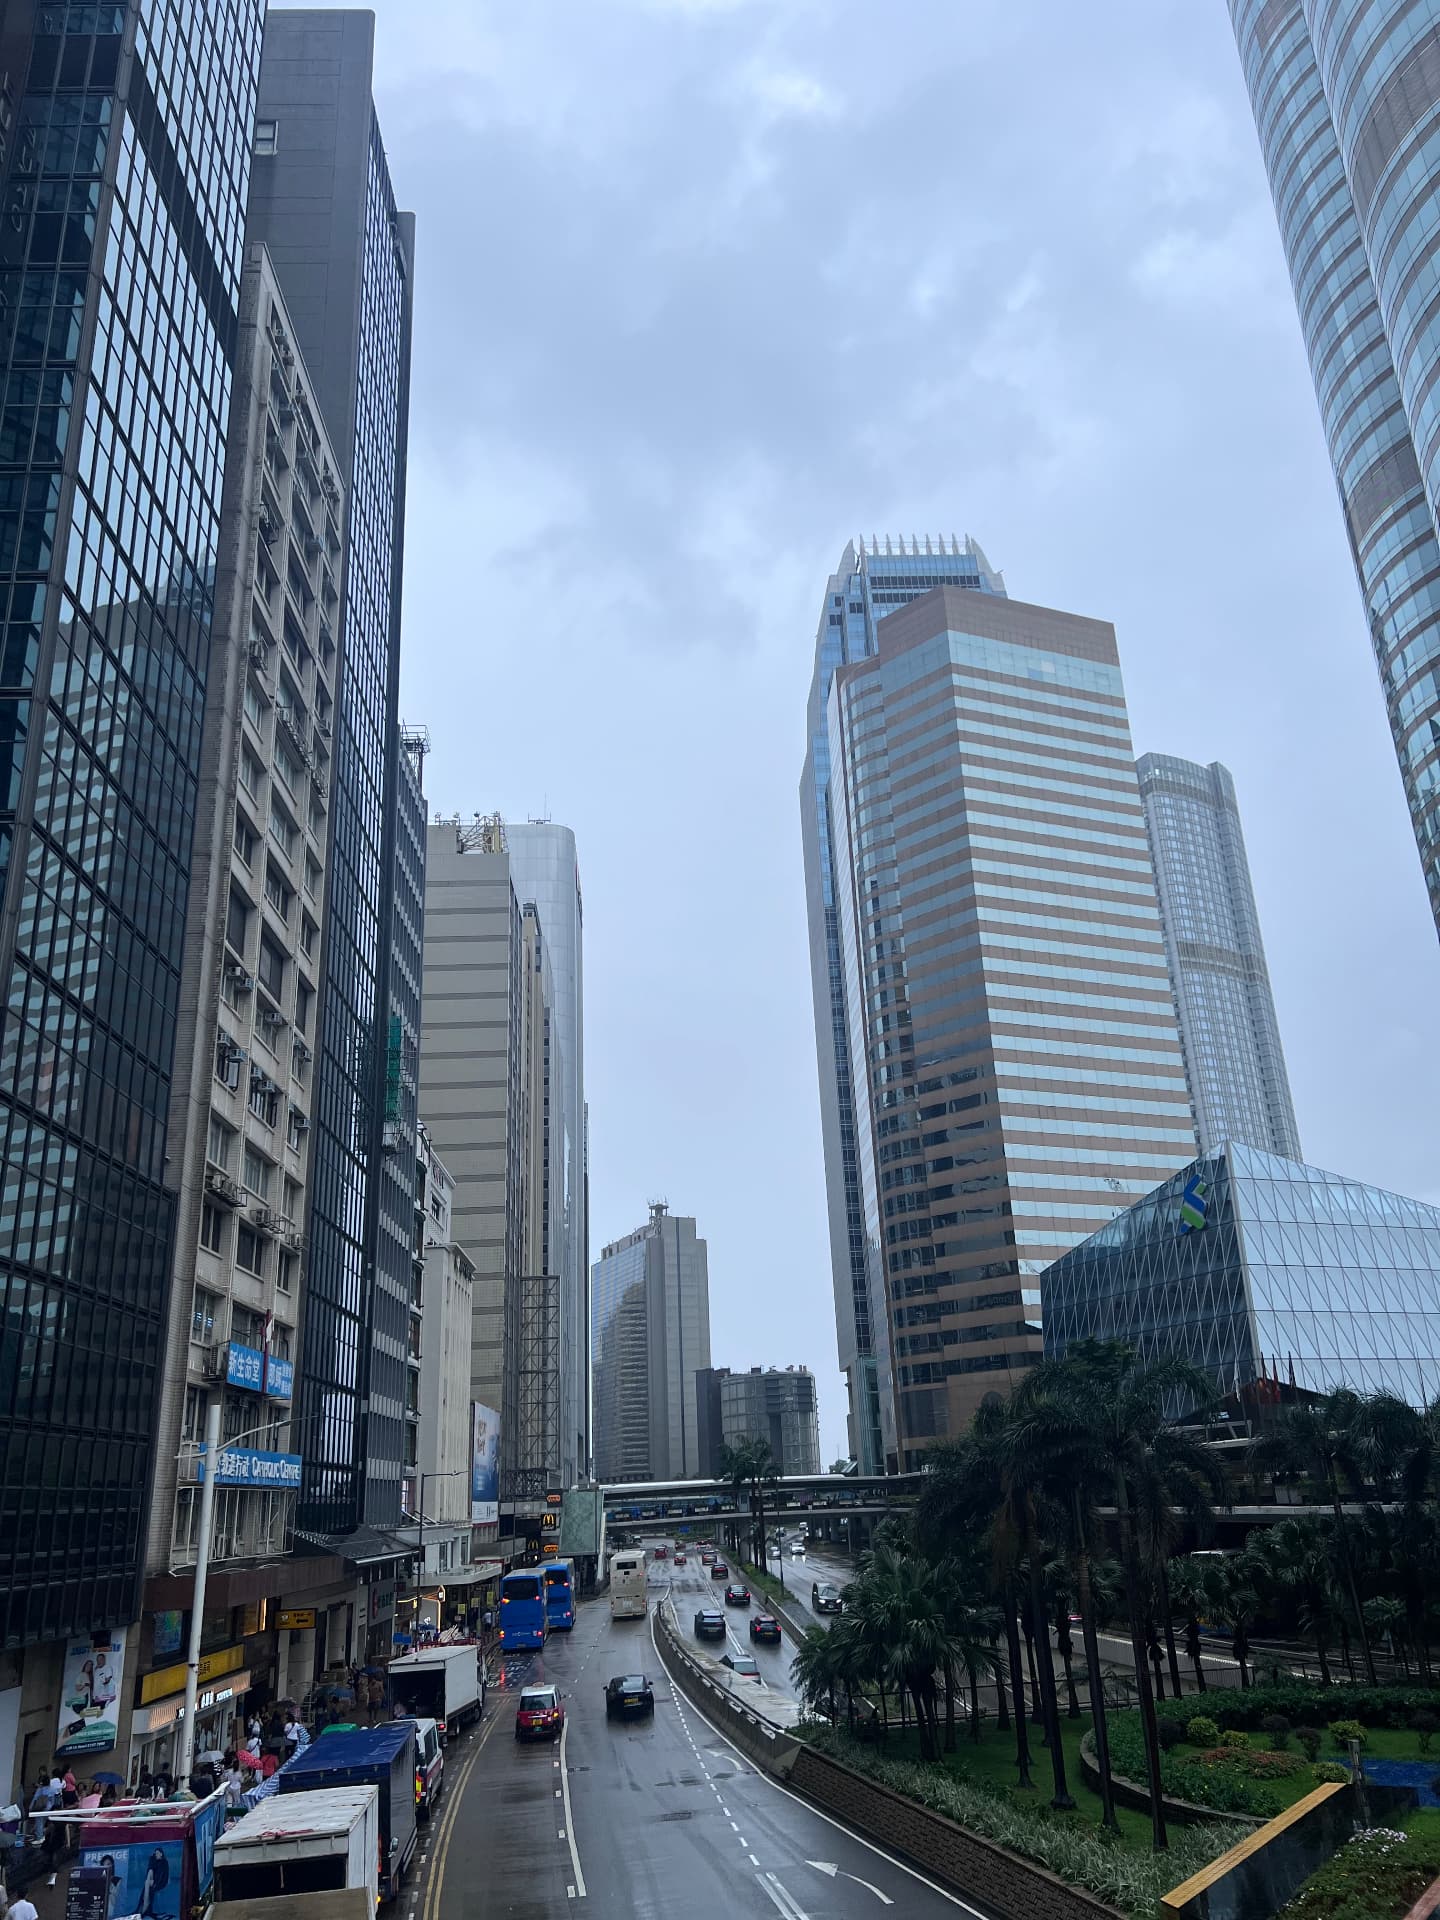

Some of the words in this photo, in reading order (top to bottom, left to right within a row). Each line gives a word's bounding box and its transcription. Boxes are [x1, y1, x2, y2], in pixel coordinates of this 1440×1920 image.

[228, 1350, 260, 1382] 新生命堂
[85, 1850, 129, 1861] PREIGE
